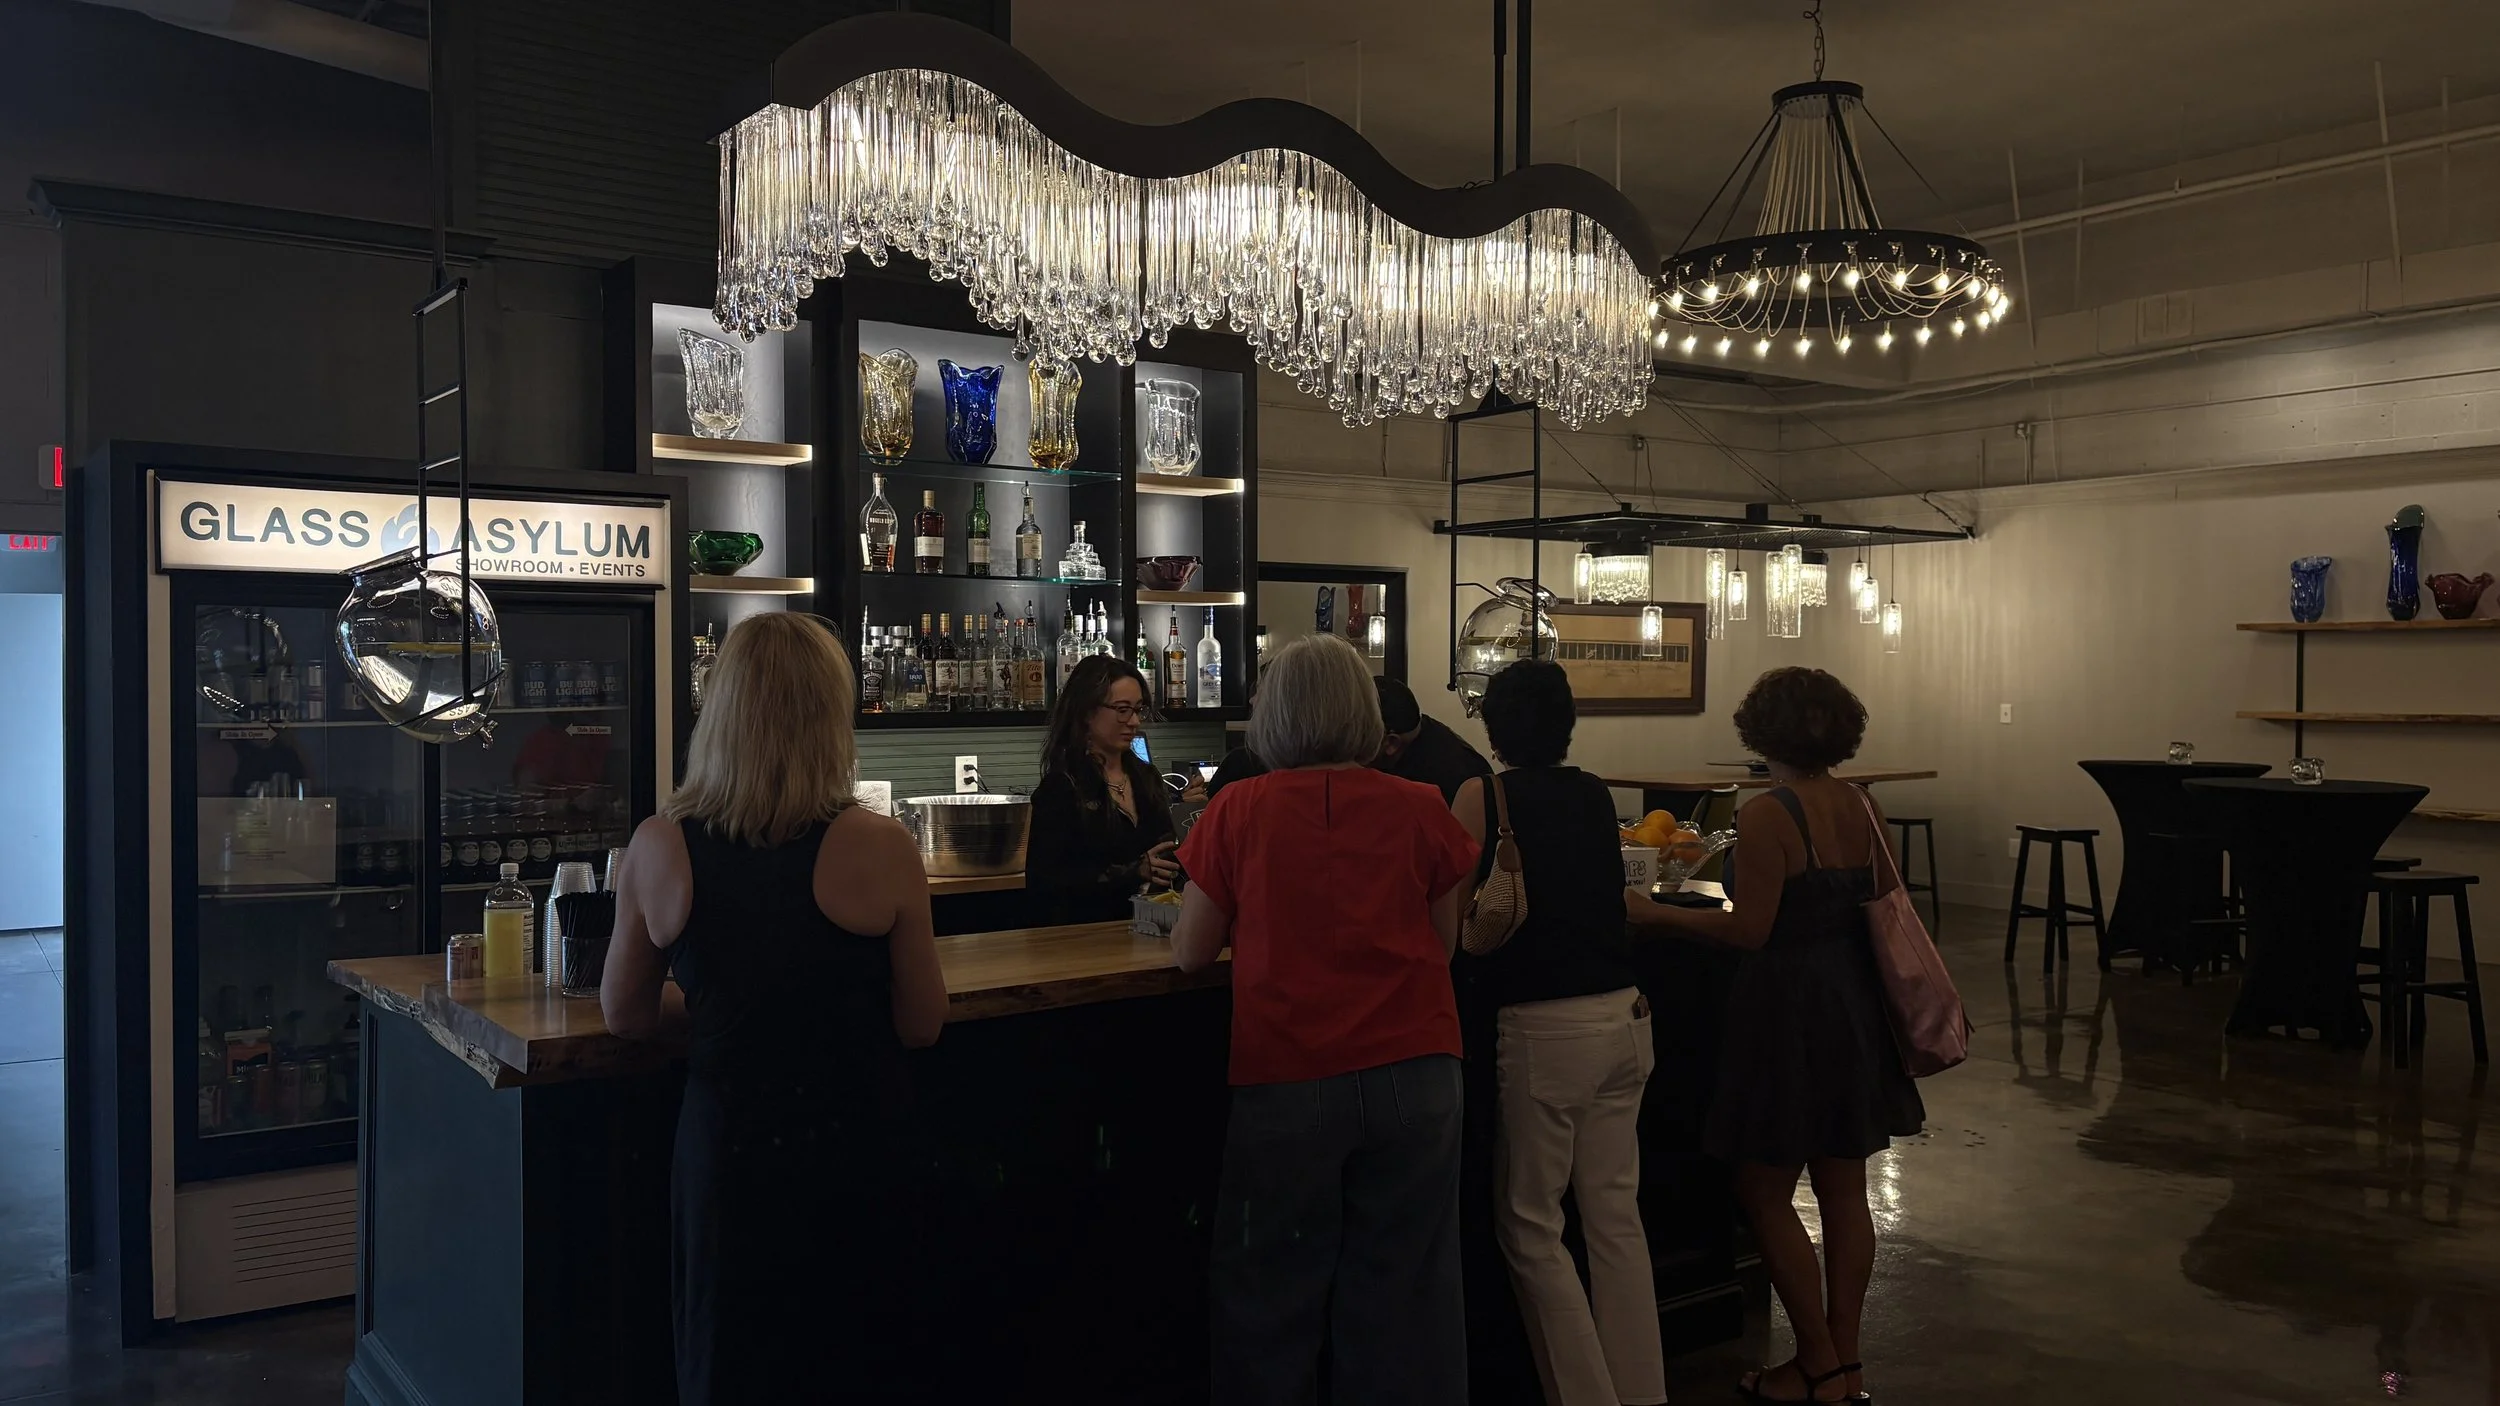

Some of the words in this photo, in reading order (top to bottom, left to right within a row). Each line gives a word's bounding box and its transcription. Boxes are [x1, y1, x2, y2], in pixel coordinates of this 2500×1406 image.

[181, 501, 370, 548] GLASS
[451, 518, 650, 559] ASYLUM
[456, 558, 563, 574] SHOWROOM
[580, 563, 645, 577] EVENTS
